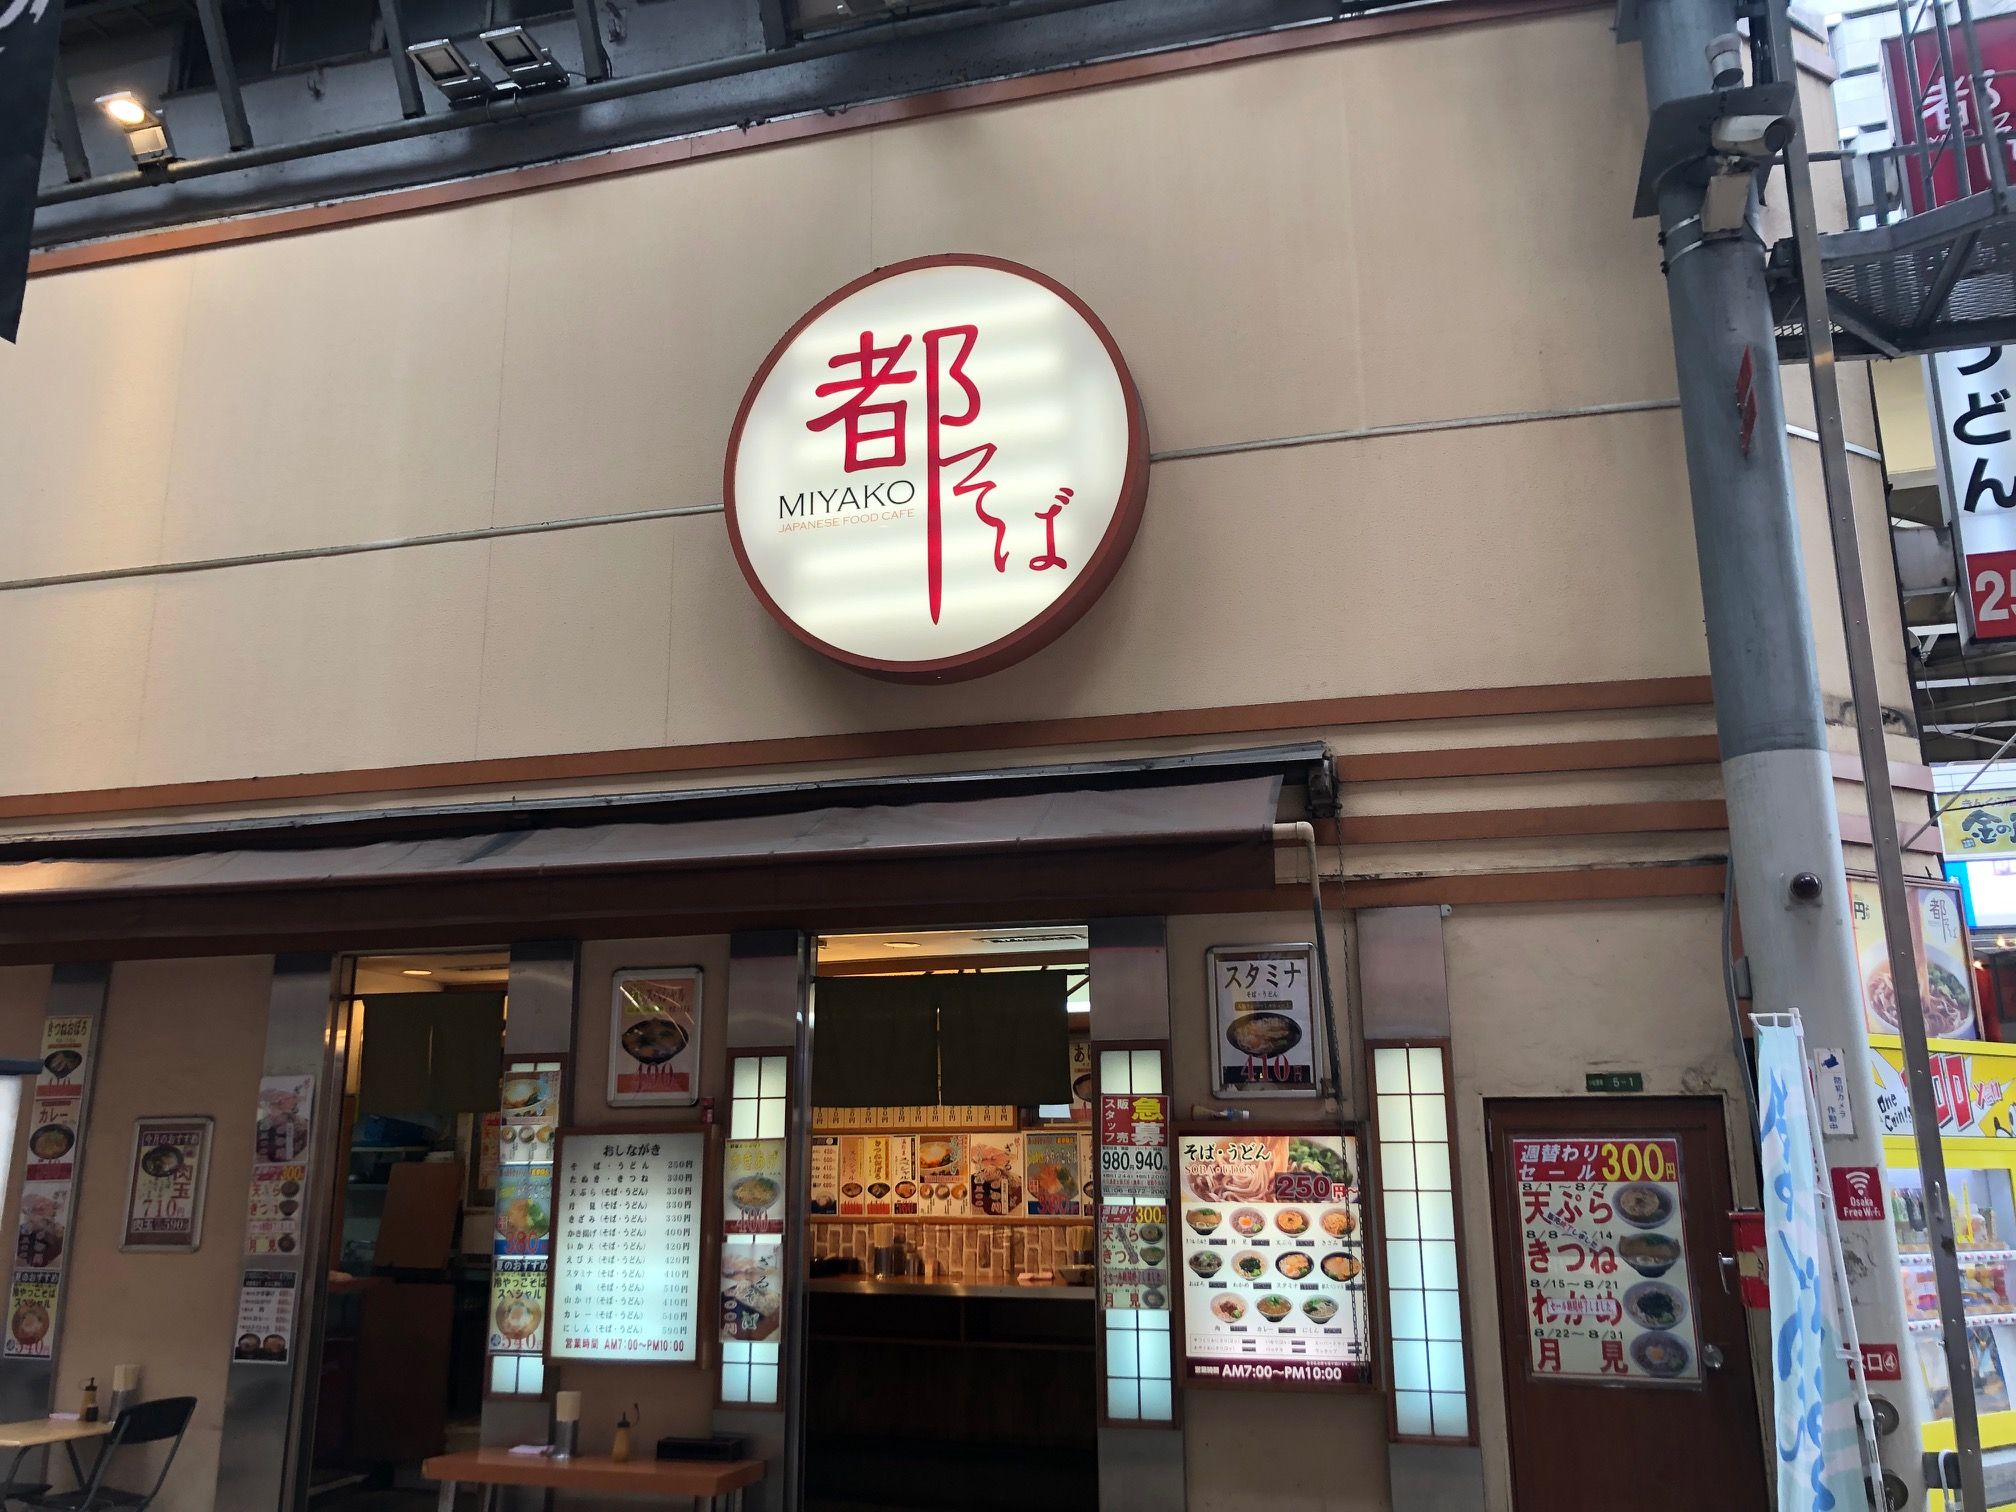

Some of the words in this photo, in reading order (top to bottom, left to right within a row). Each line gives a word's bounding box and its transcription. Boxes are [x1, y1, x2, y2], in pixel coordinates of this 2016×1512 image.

[806, 324, 980, 626] 都
[778, 479, 916, 520] MIYAKO
[938, 443, 1075, 573] そば
[778, 517, 840, 534] JAPANESE
[842, 511, 879, 527] FOOD
[880, 508, 916, 523] CAFE
[1975, 568, 2016, 622] 2
[1225, 962, 1302, 989] スタミナ
[38, 1108, 69, 1123] カレー
[1104, 1098, 1117, 1143] スタッフ
[1131, 1097, 1165, 1146] 急募
[602, 1142, 661, 1157] おしながき
[1184, 1142, 1272, 1161] そば・うどん
[1520, 1144, 1599, 1162] 週替わり
[1601, 1143, 1677, 1181] 300円
[1519, 1163, 1596, 1181] セール
[1522, 1190, 1614, 1225] 天ぷら
[1849, 1196, 1874, 1206] Osaka
[568, 1214, 596, 1224] きざみ
[1843, 1206, 1864, 1217] Free
[1528, 1238, 1618, 1274] きつね
[566, 1269, 593, 1278] スタミナ
[1104, 1292, 1141, 1308] 月見
[564, 1310, 592, 1319] カレー
[563, 1324, 590, 1333] にしん
[565, 1338, 599, 1349] 営業時間
[1537, 1338, 1629, 1374] 月見
